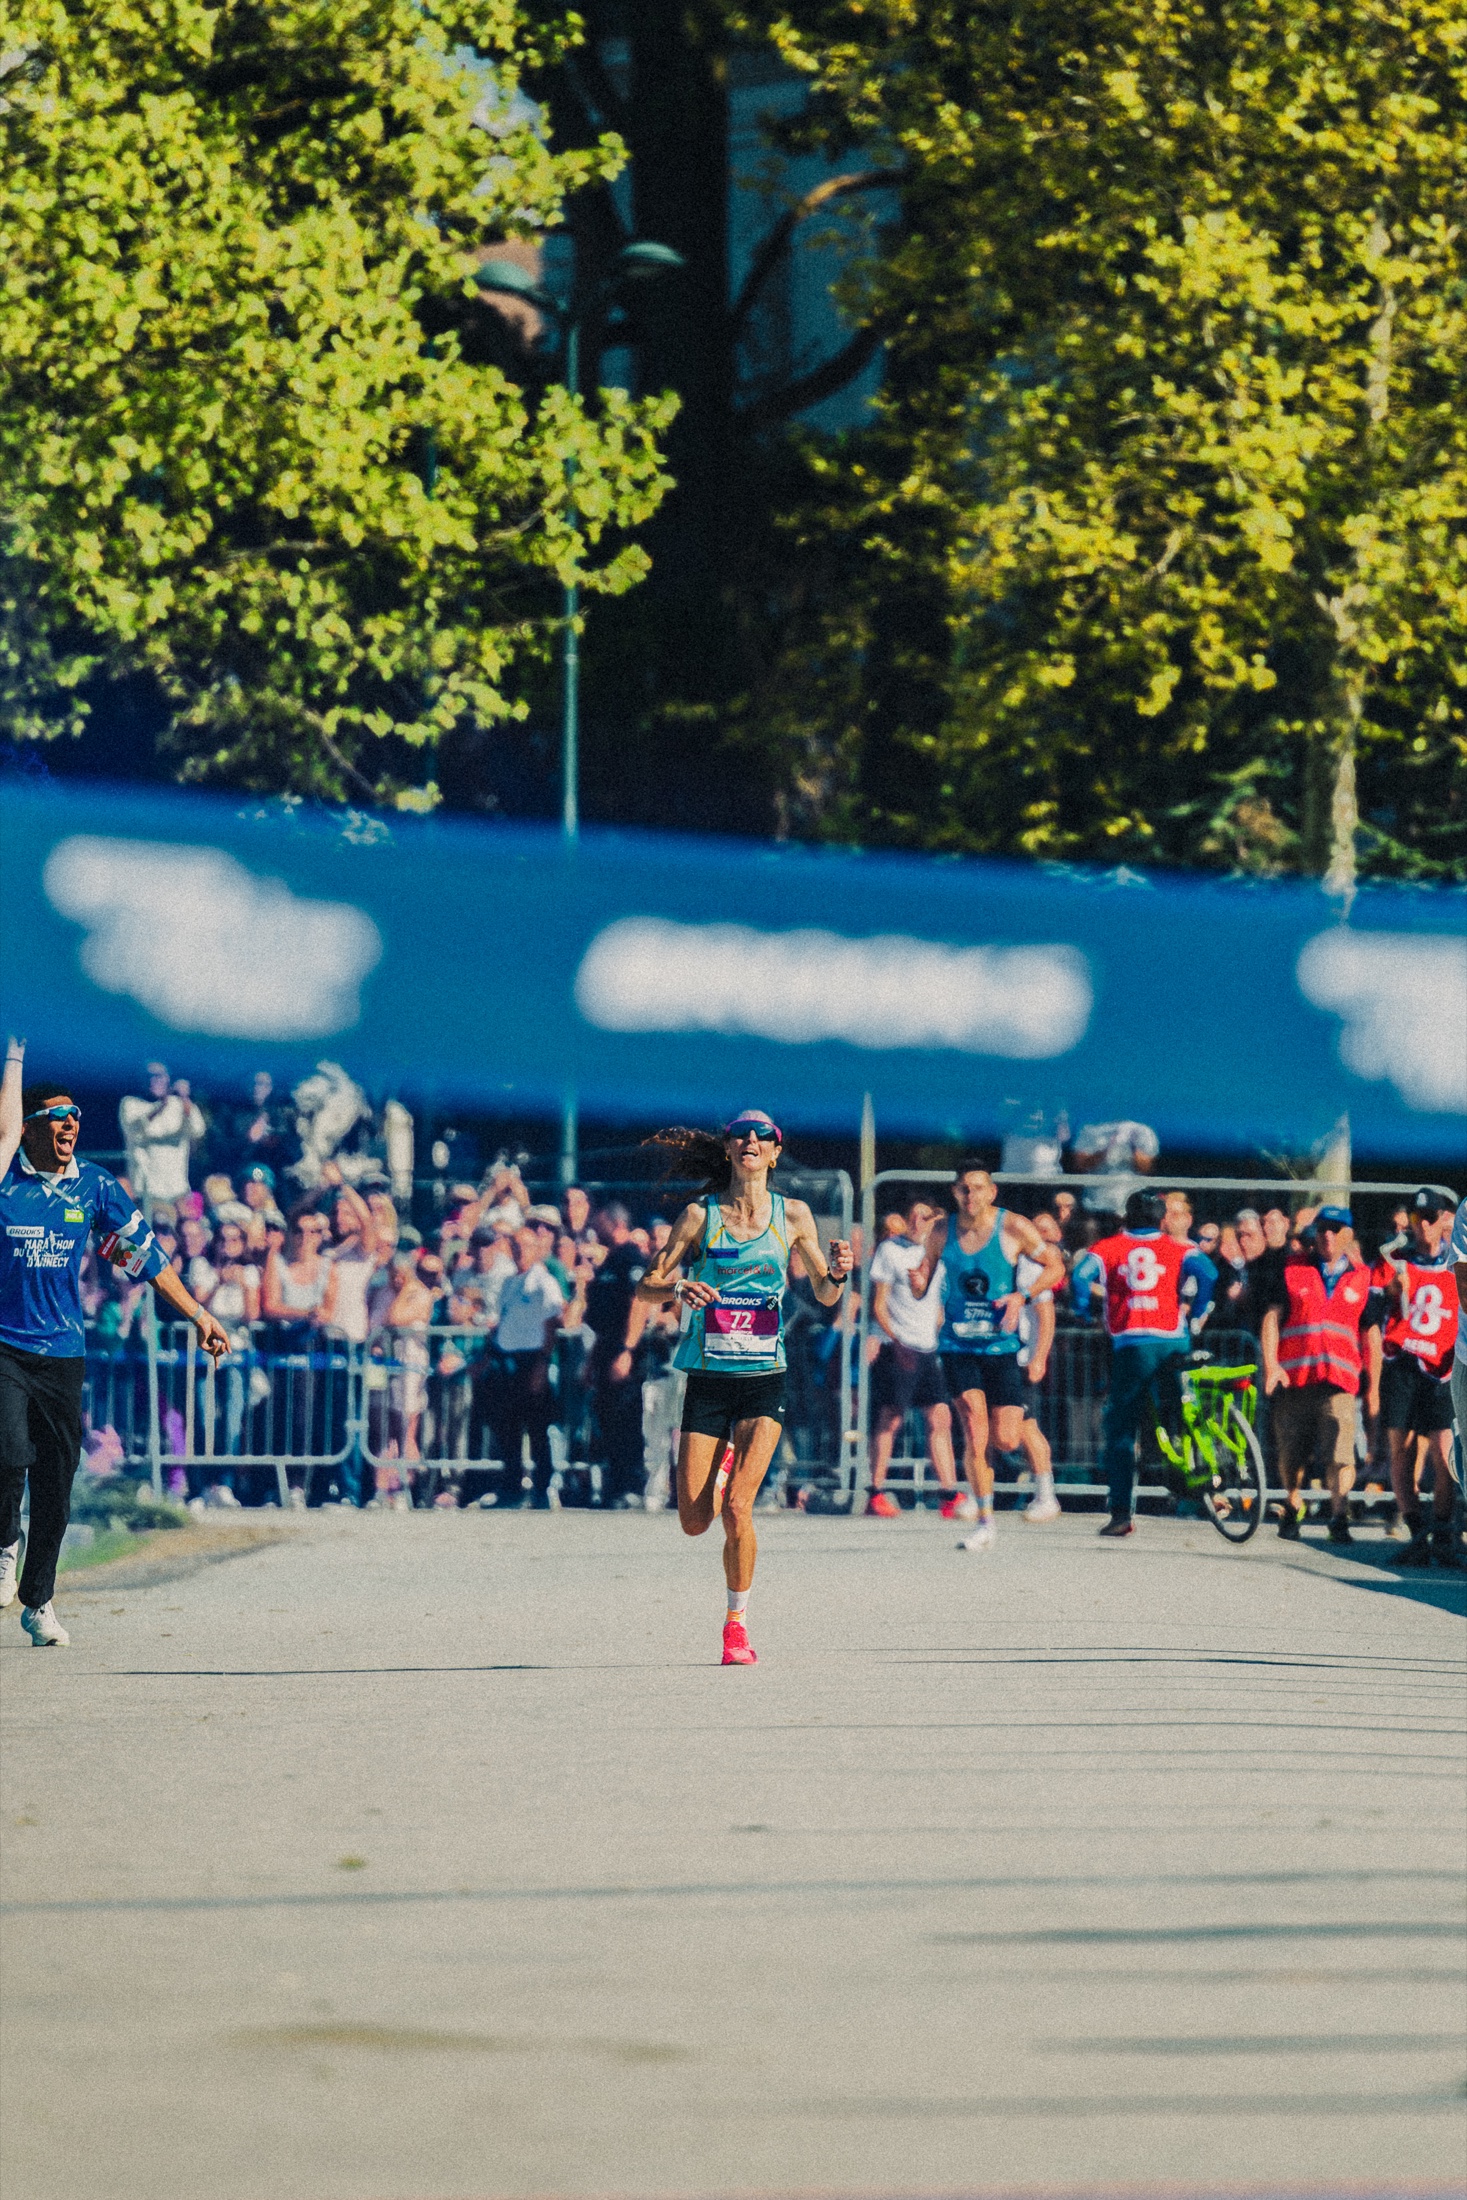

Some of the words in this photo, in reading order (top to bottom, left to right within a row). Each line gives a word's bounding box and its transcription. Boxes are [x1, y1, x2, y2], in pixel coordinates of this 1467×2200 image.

[9, 1228, 41, 1236] BROOKS
[25, 1239, 75, 1249] MARATHON
[13, 1248, 24, 1257] DU
[26, 1249, 41, 1257] LAC
[27, 1257, 69, 1267] D'ANNECY
[717, 1265, 752, 1275] marcel
[753, 1266, 761, 1275] &
[722, 1297, 762, 1306] BROOKS
[730, 1311, 752, 1329] 72
